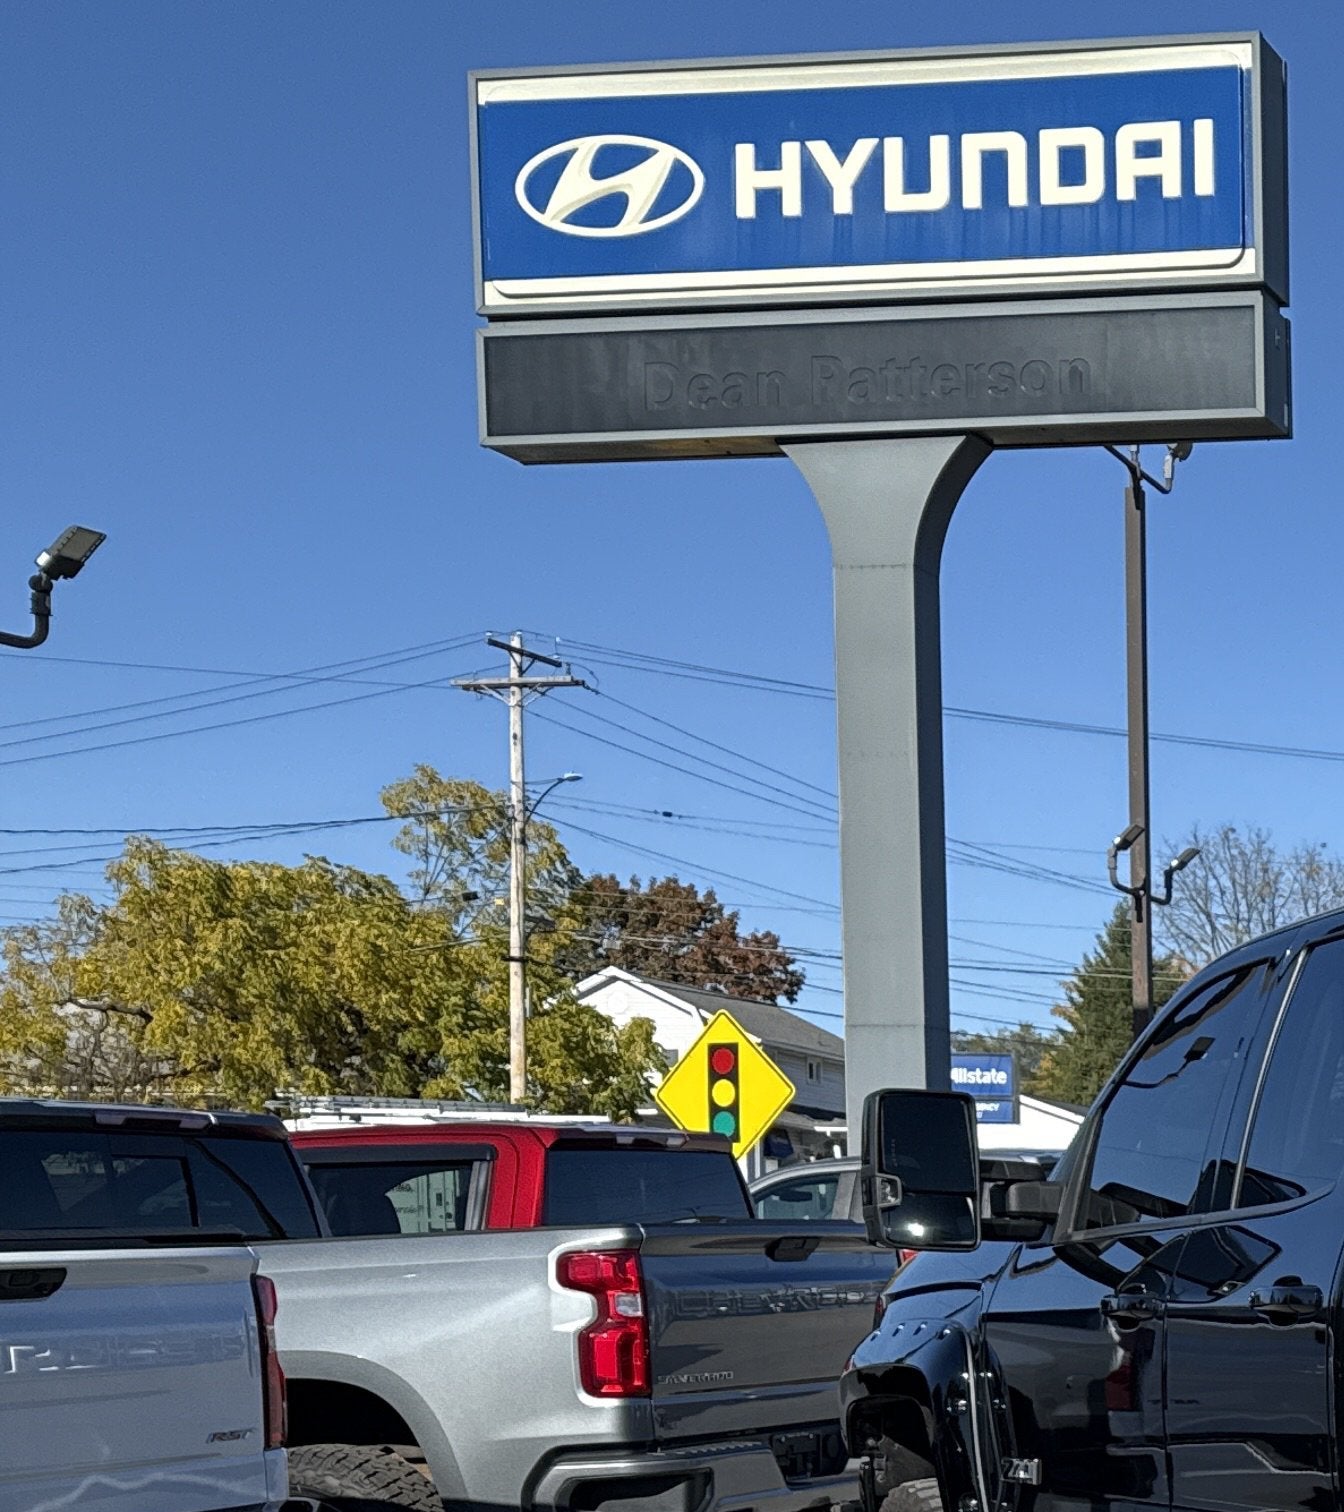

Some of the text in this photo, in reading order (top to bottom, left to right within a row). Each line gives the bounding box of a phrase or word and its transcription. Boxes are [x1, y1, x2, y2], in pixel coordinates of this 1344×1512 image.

[735, 117, 1215, 219] HYUNDAI
[642, 354, 1093, 411] Dean Patterson
